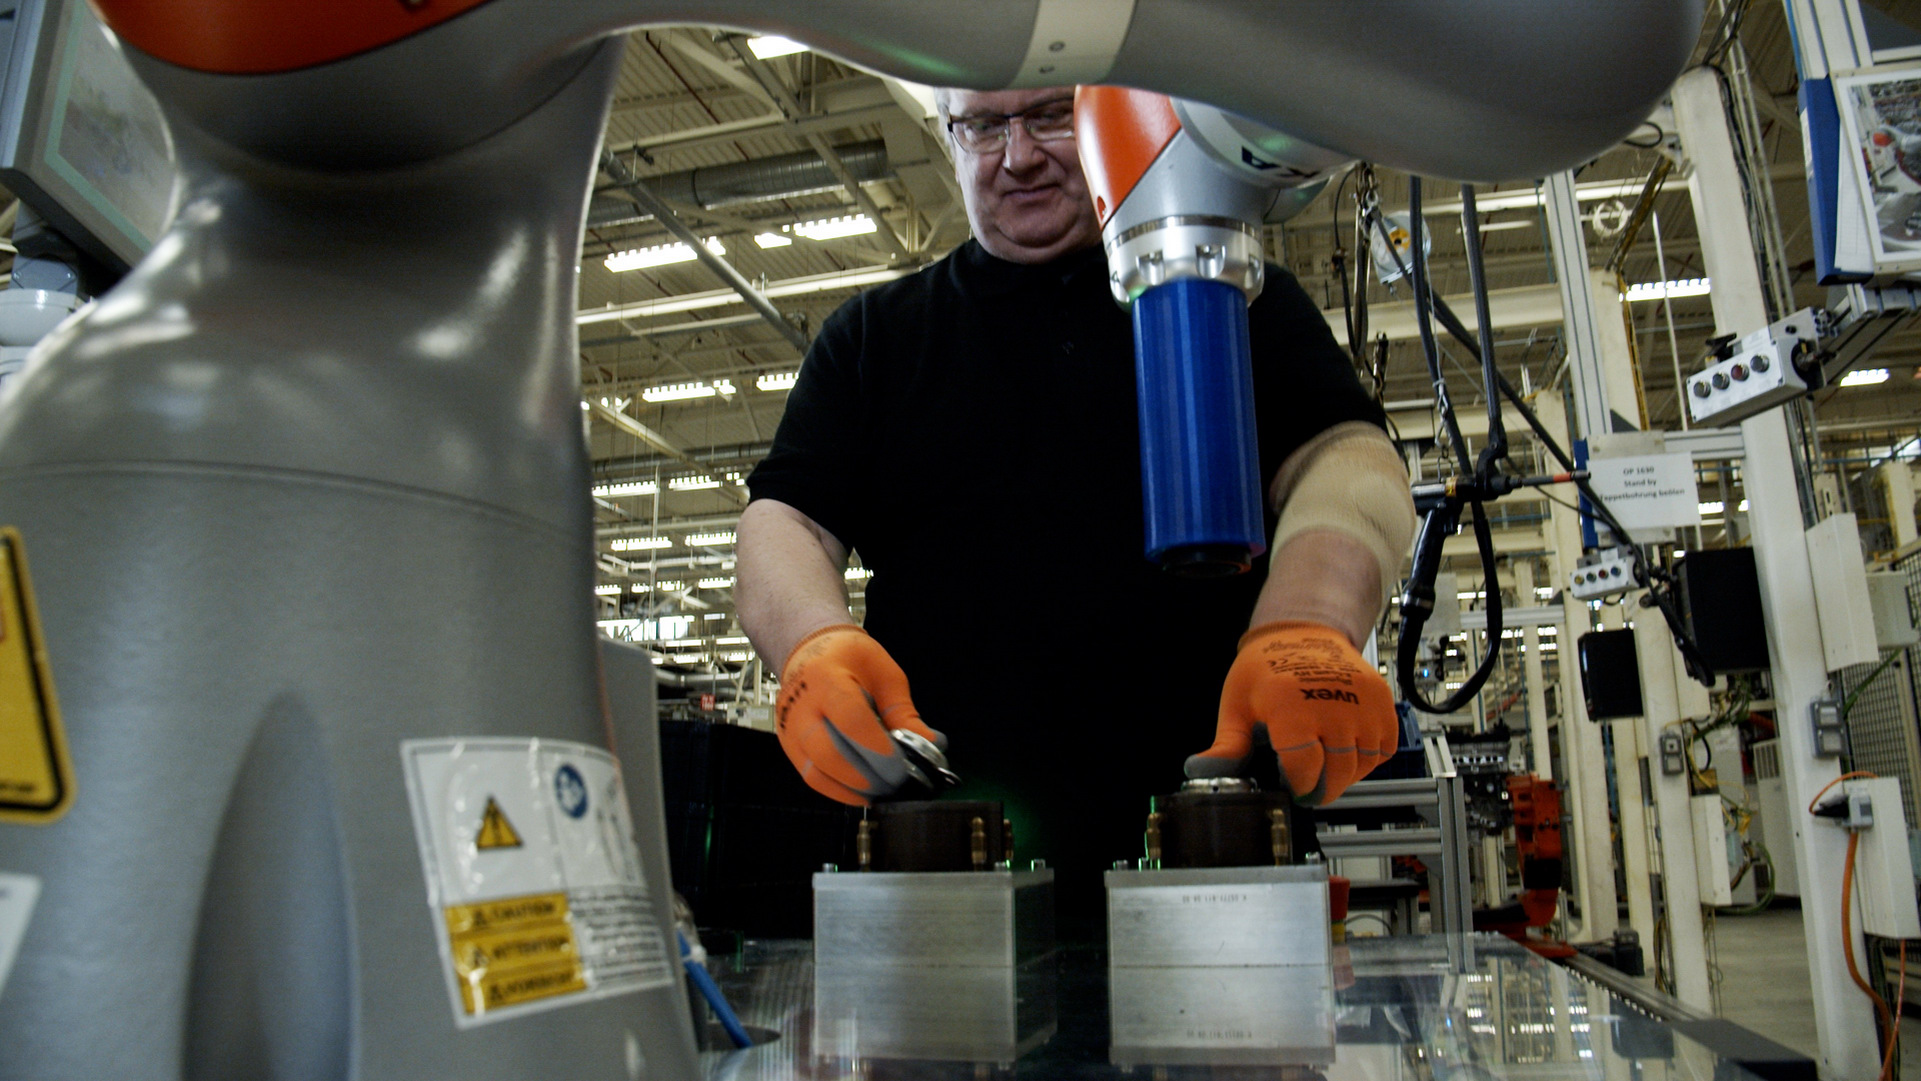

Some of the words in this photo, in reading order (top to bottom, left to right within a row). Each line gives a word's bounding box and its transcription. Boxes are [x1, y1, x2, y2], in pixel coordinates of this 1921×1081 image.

[1623, 466, 1634, 475] OP
[1636, 466, 1655, 475] 1630
[1624, 479, 1646, 487] Stand
[1647, 478, 1657, 486] by
[1300, 688, 1360, 705] uvex
